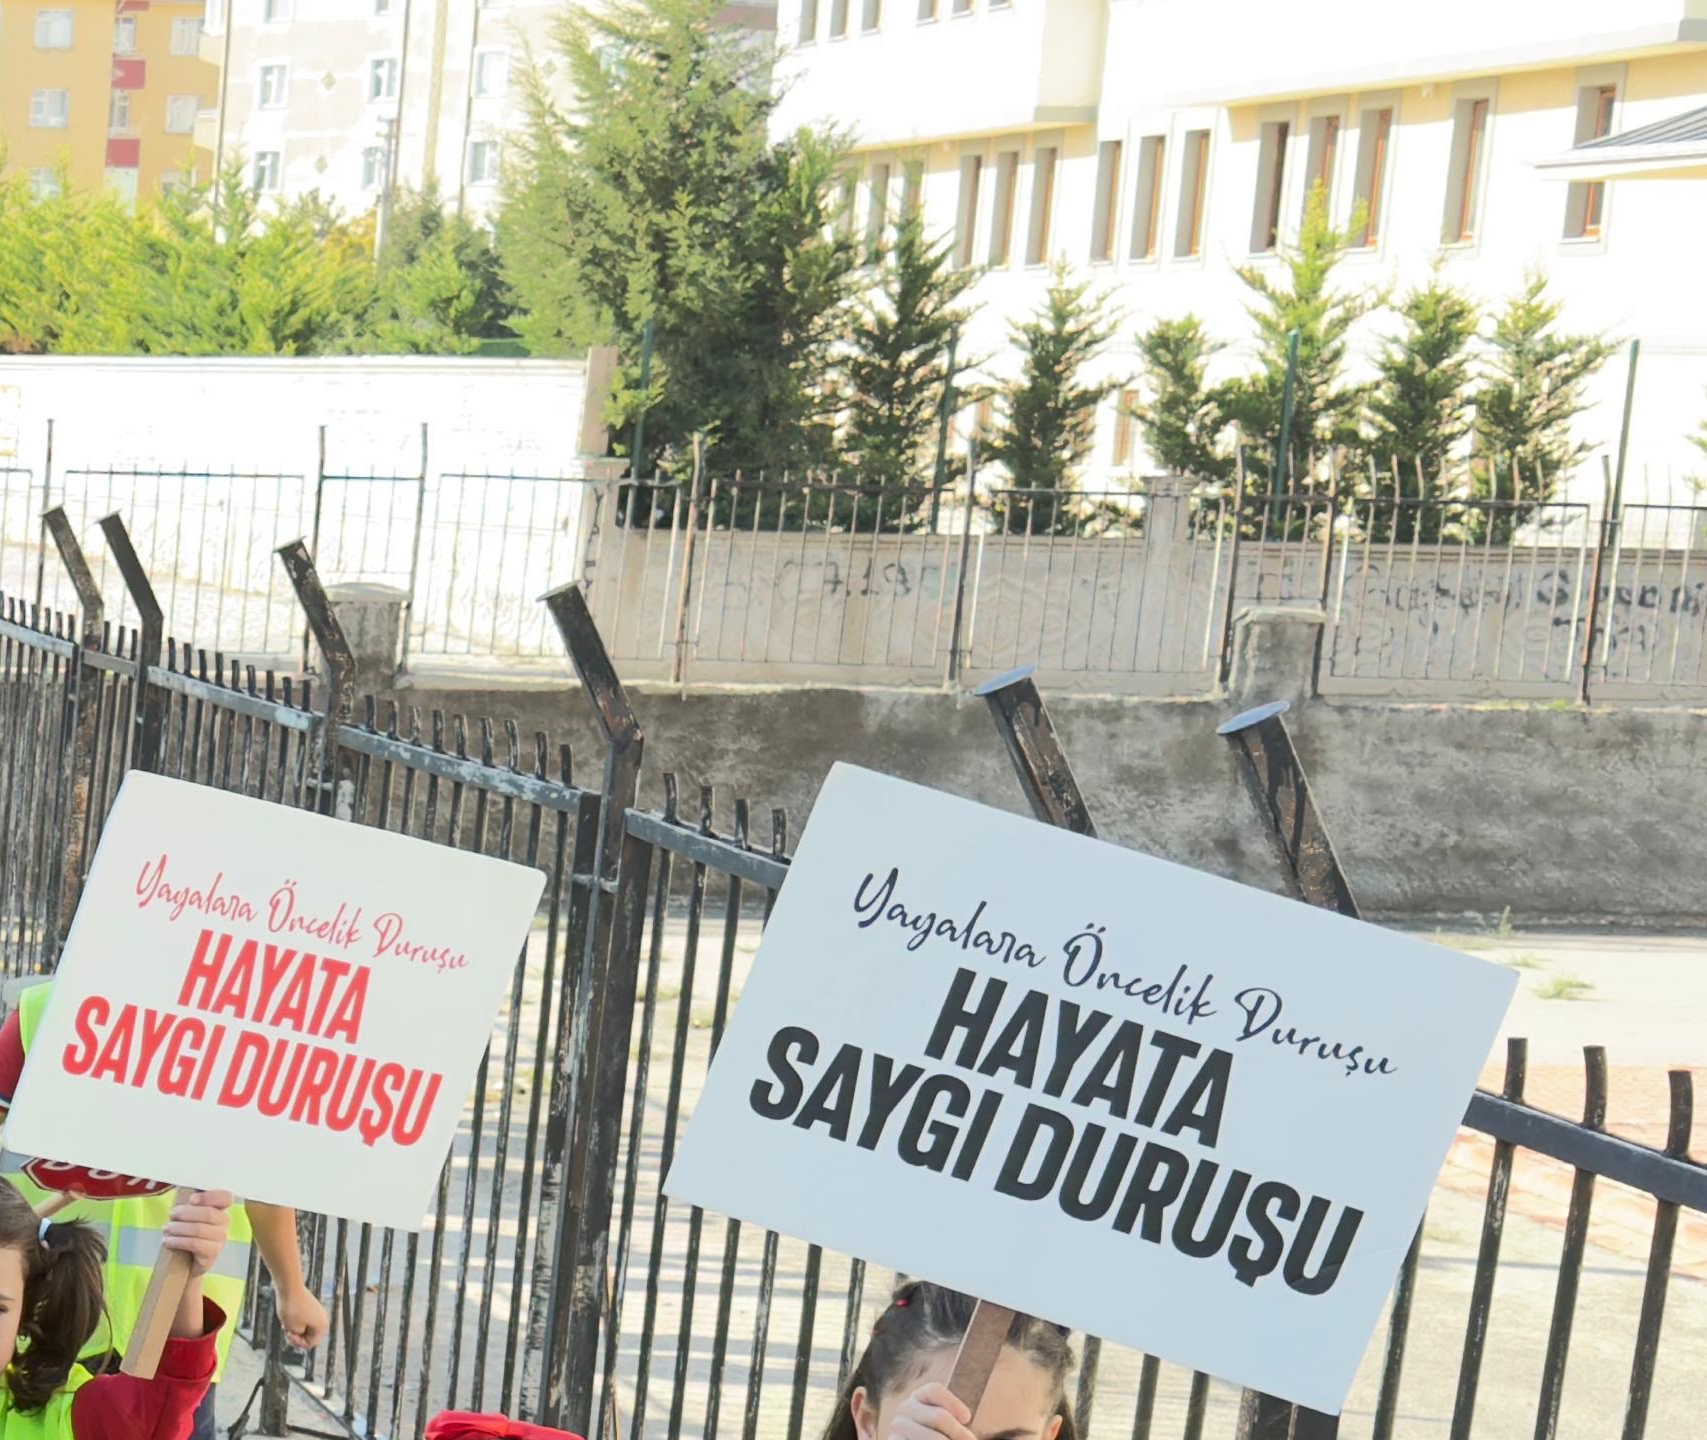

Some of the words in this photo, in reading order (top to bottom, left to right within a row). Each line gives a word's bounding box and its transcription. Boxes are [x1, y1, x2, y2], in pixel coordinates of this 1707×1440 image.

[135, 854, 258, 923] Yayalara
[267, 879, 363, 950] Öncelik
[372, 912, 469, 973] Duruşu
[176, 929, 371, 1044] HAYATA
[853, 868, 1047, 969] Yayalara
[1062, 923, 1219, 1023] Öncelik
[1233, 987, 1398, 1078] Duruşu
[61, 995, 227, 1103] SAYGI
[216, 1031, 443, 1147] DURUŞU
[923, 966, 1234, 1150] HAYATA
[749, 1024, 1005, 1184] SAYGI
[993, 1101, 1364, 1297] DURUŞU
